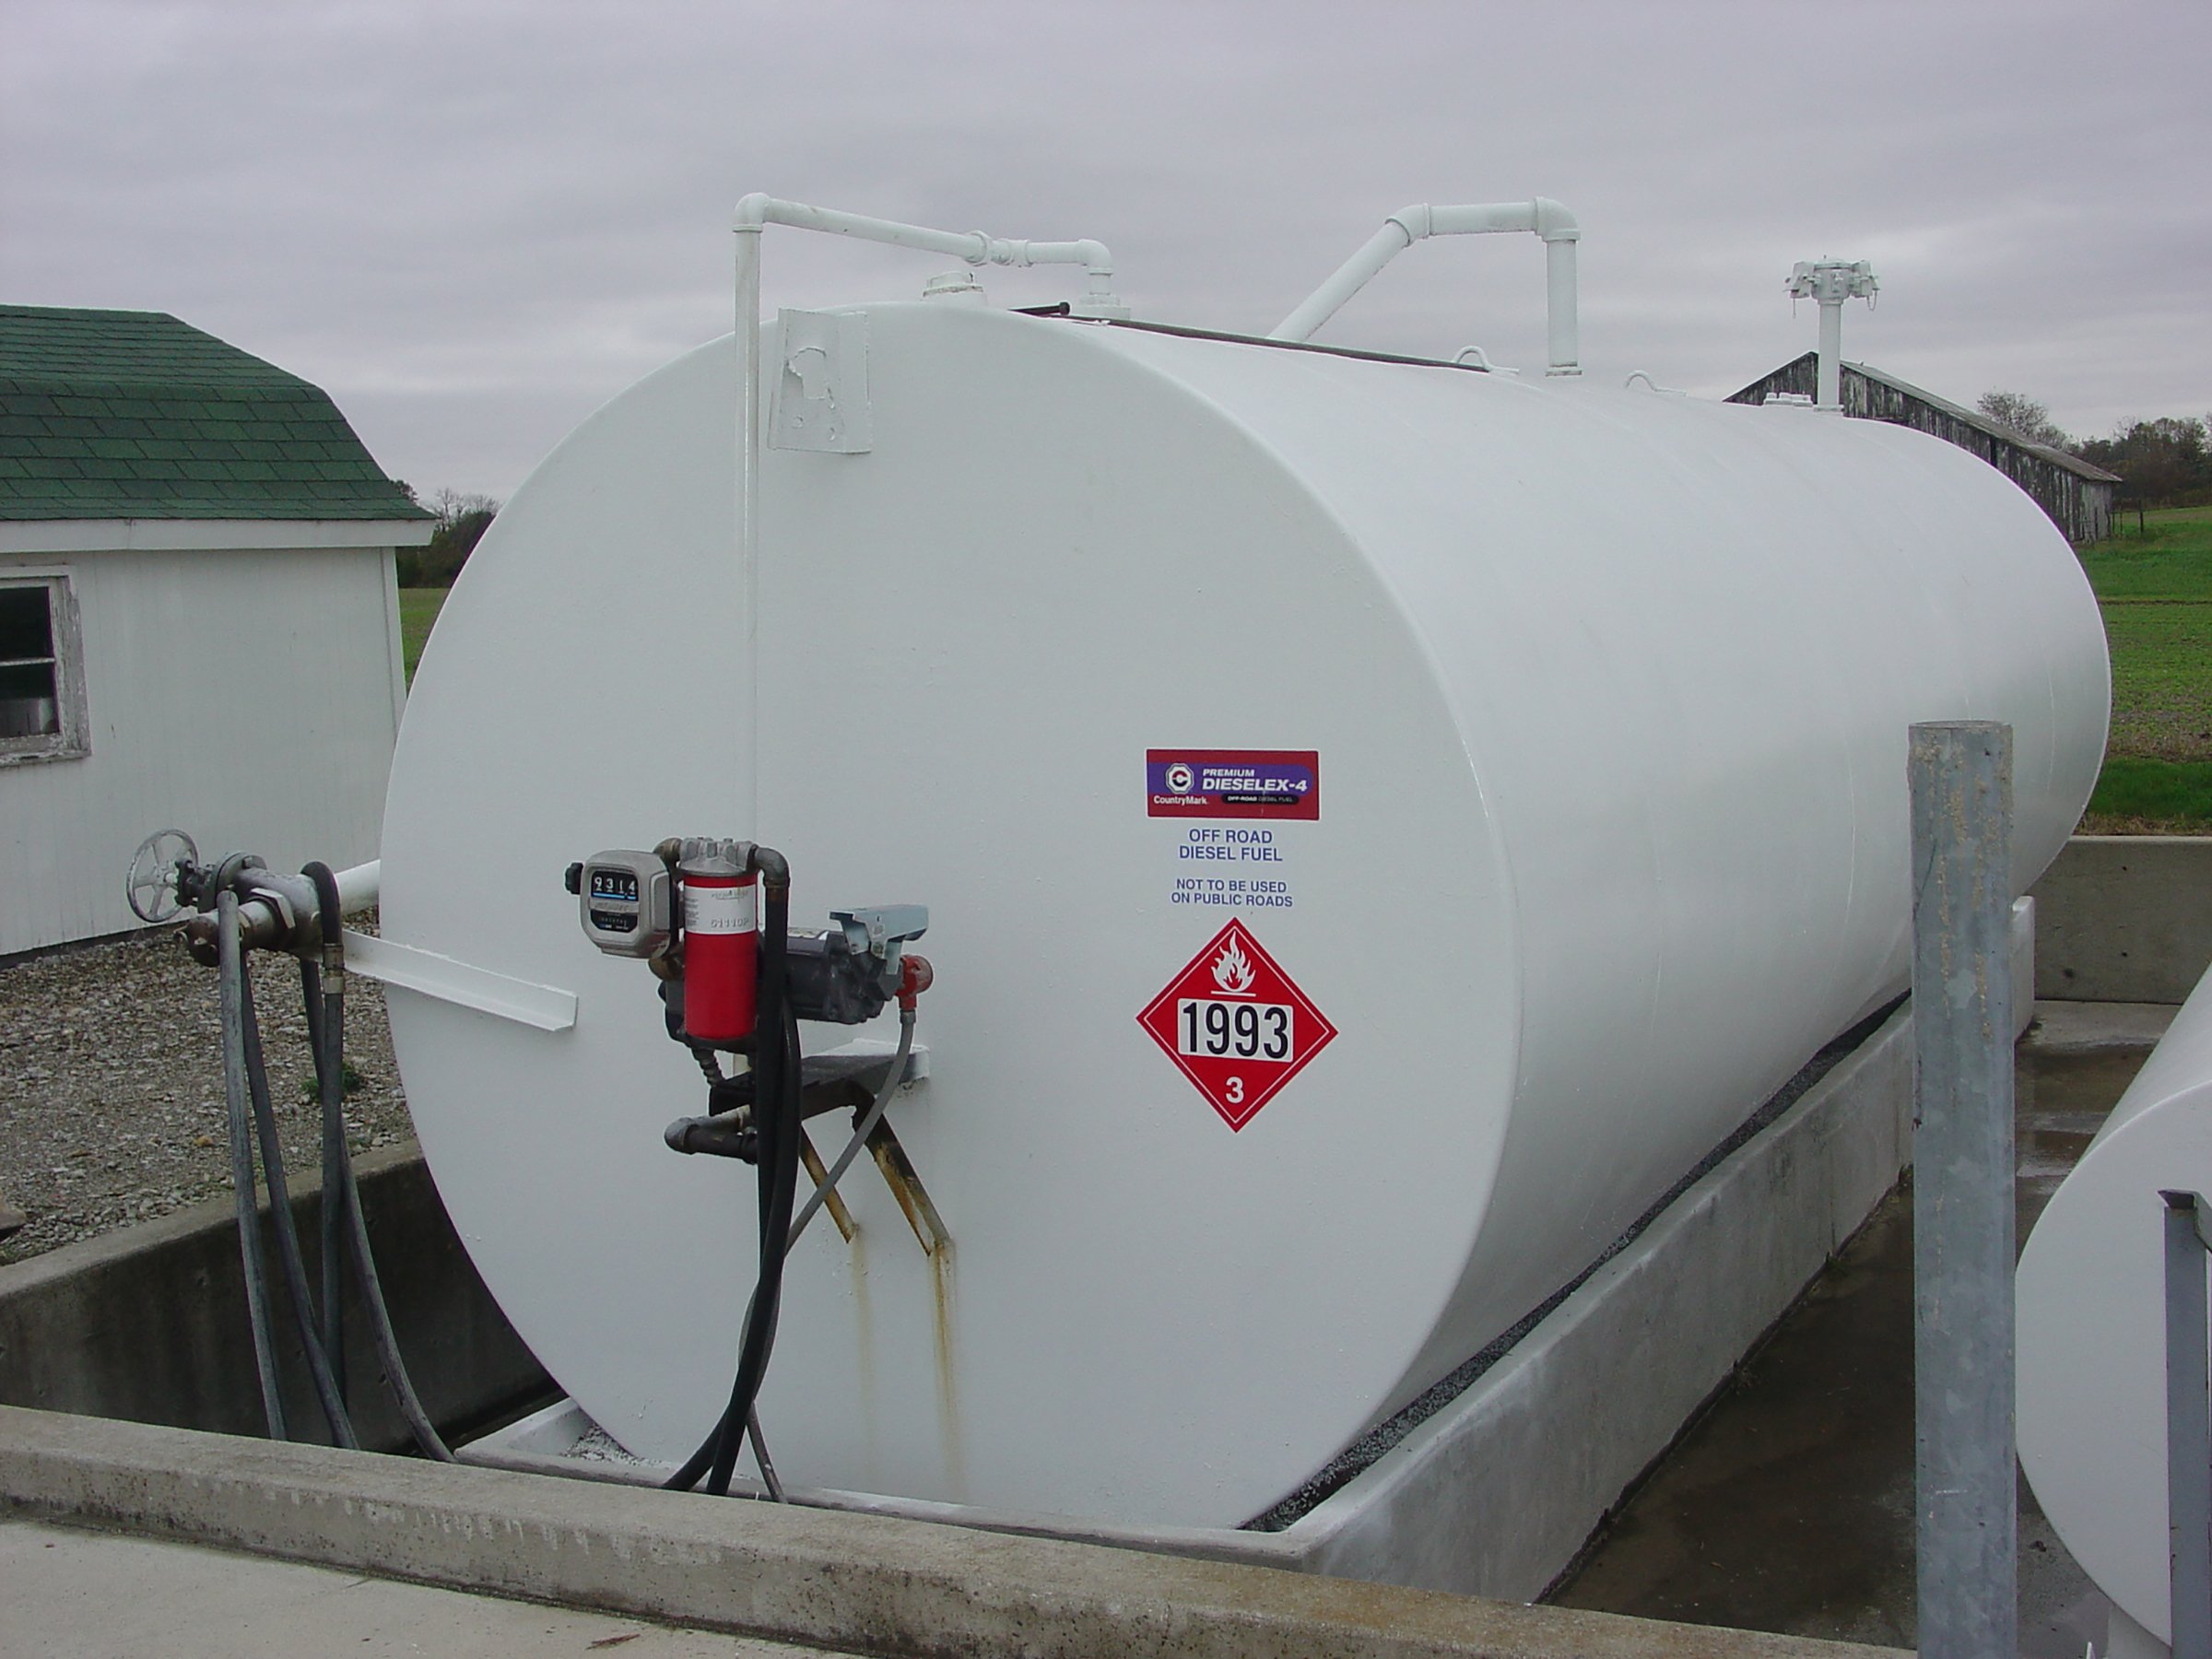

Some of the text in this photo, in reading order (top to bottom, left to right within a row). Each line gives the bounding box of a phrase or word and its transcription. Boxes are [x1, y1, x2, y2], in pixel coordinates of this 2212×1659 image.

[1202, 768, 1255, 778] PREMIUM
[1201, 778, 1308, 793] DIESELEX-4
[1153, 794, 1208, 806] CountryMark
[1188, 829, 1273, 844] OFF ROAD
[1179, 845, 1284, 862] DIESEL FUEL
[1176, 878, 1287, 893] NOT TO BE USED
[1171, 892, 1293, 908] ON PUBLIC ROADS
[1182, 1001, 1289, 1060] 1993
[1225, 1076, 1244, 1104] 3
